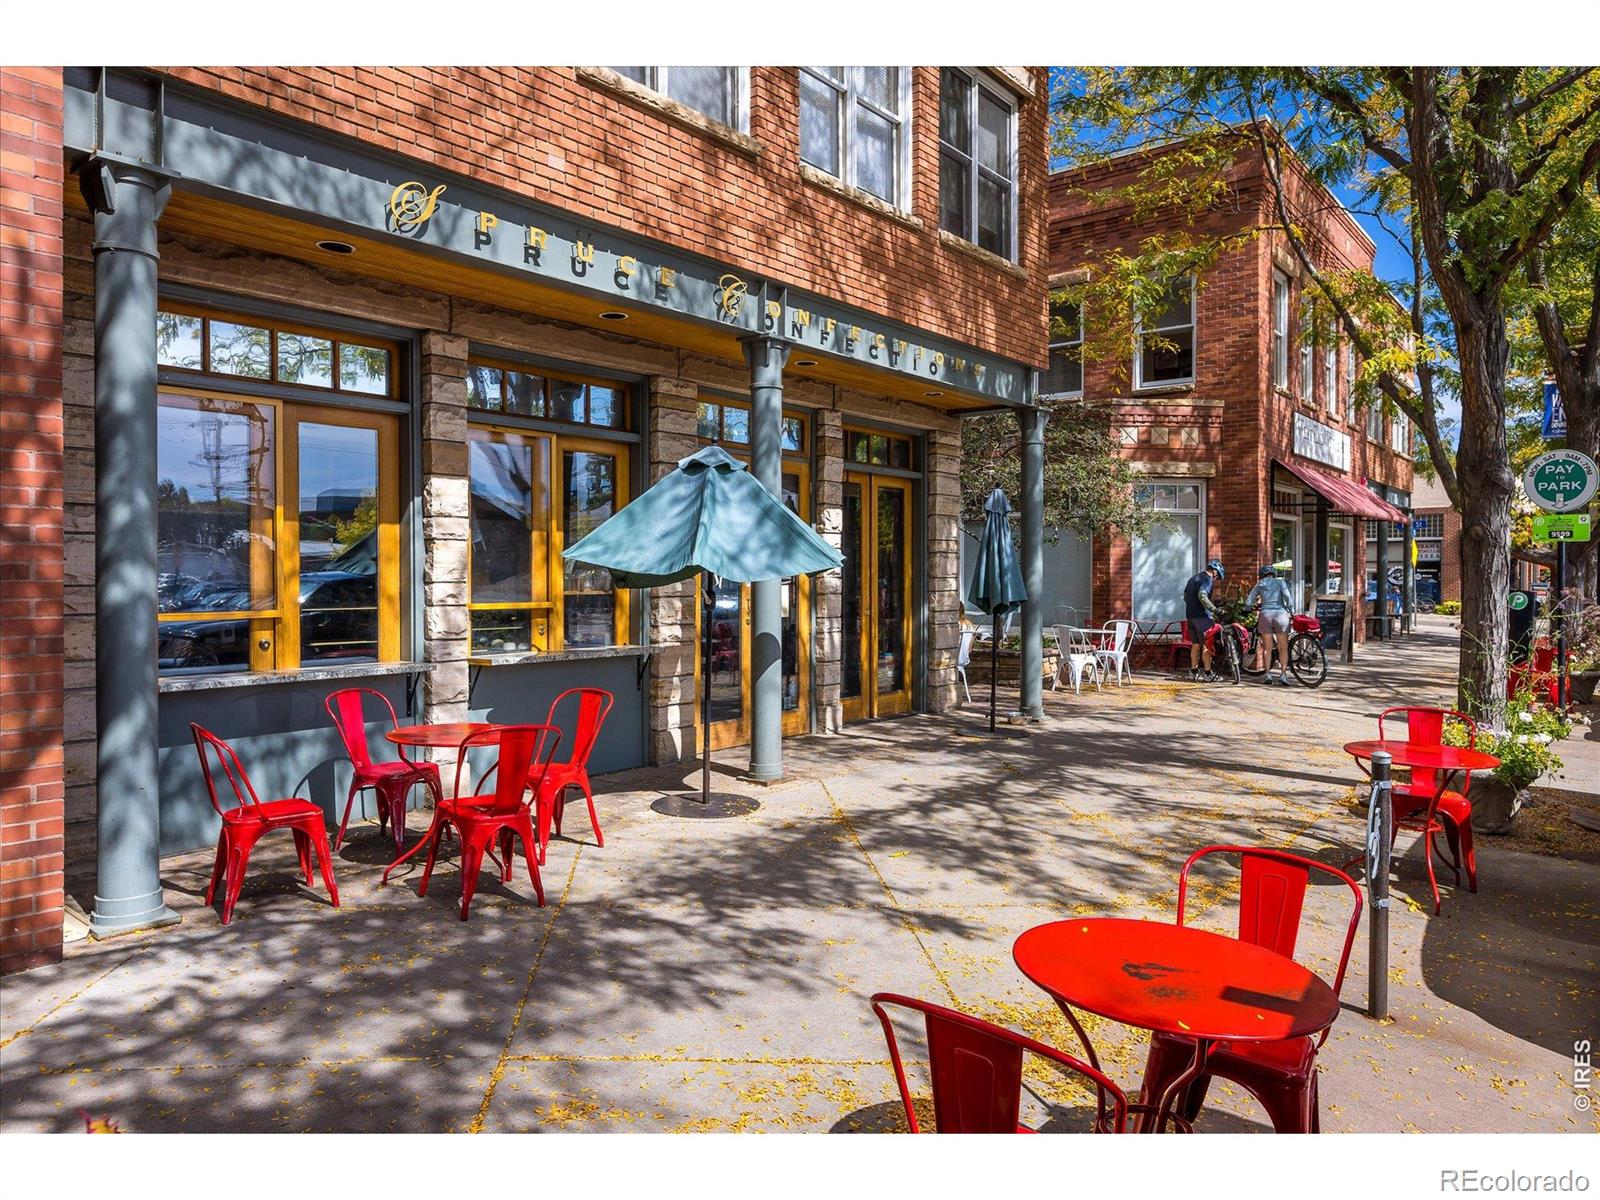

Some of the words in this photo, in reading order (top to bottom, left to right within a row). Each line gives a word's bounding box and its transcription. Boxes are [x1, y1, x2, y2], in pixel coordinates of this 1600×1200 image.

[389, 181, 676, 289] SPRUCE
[718, 274, 986, 377] CONFECTIONS
[1528, 462, 1541, 478] MON
[1543, 453, 1557, 461] SAT
[1545, 464, 1575, 474] PAY
[1538, 481, 1582, 491] PARK
